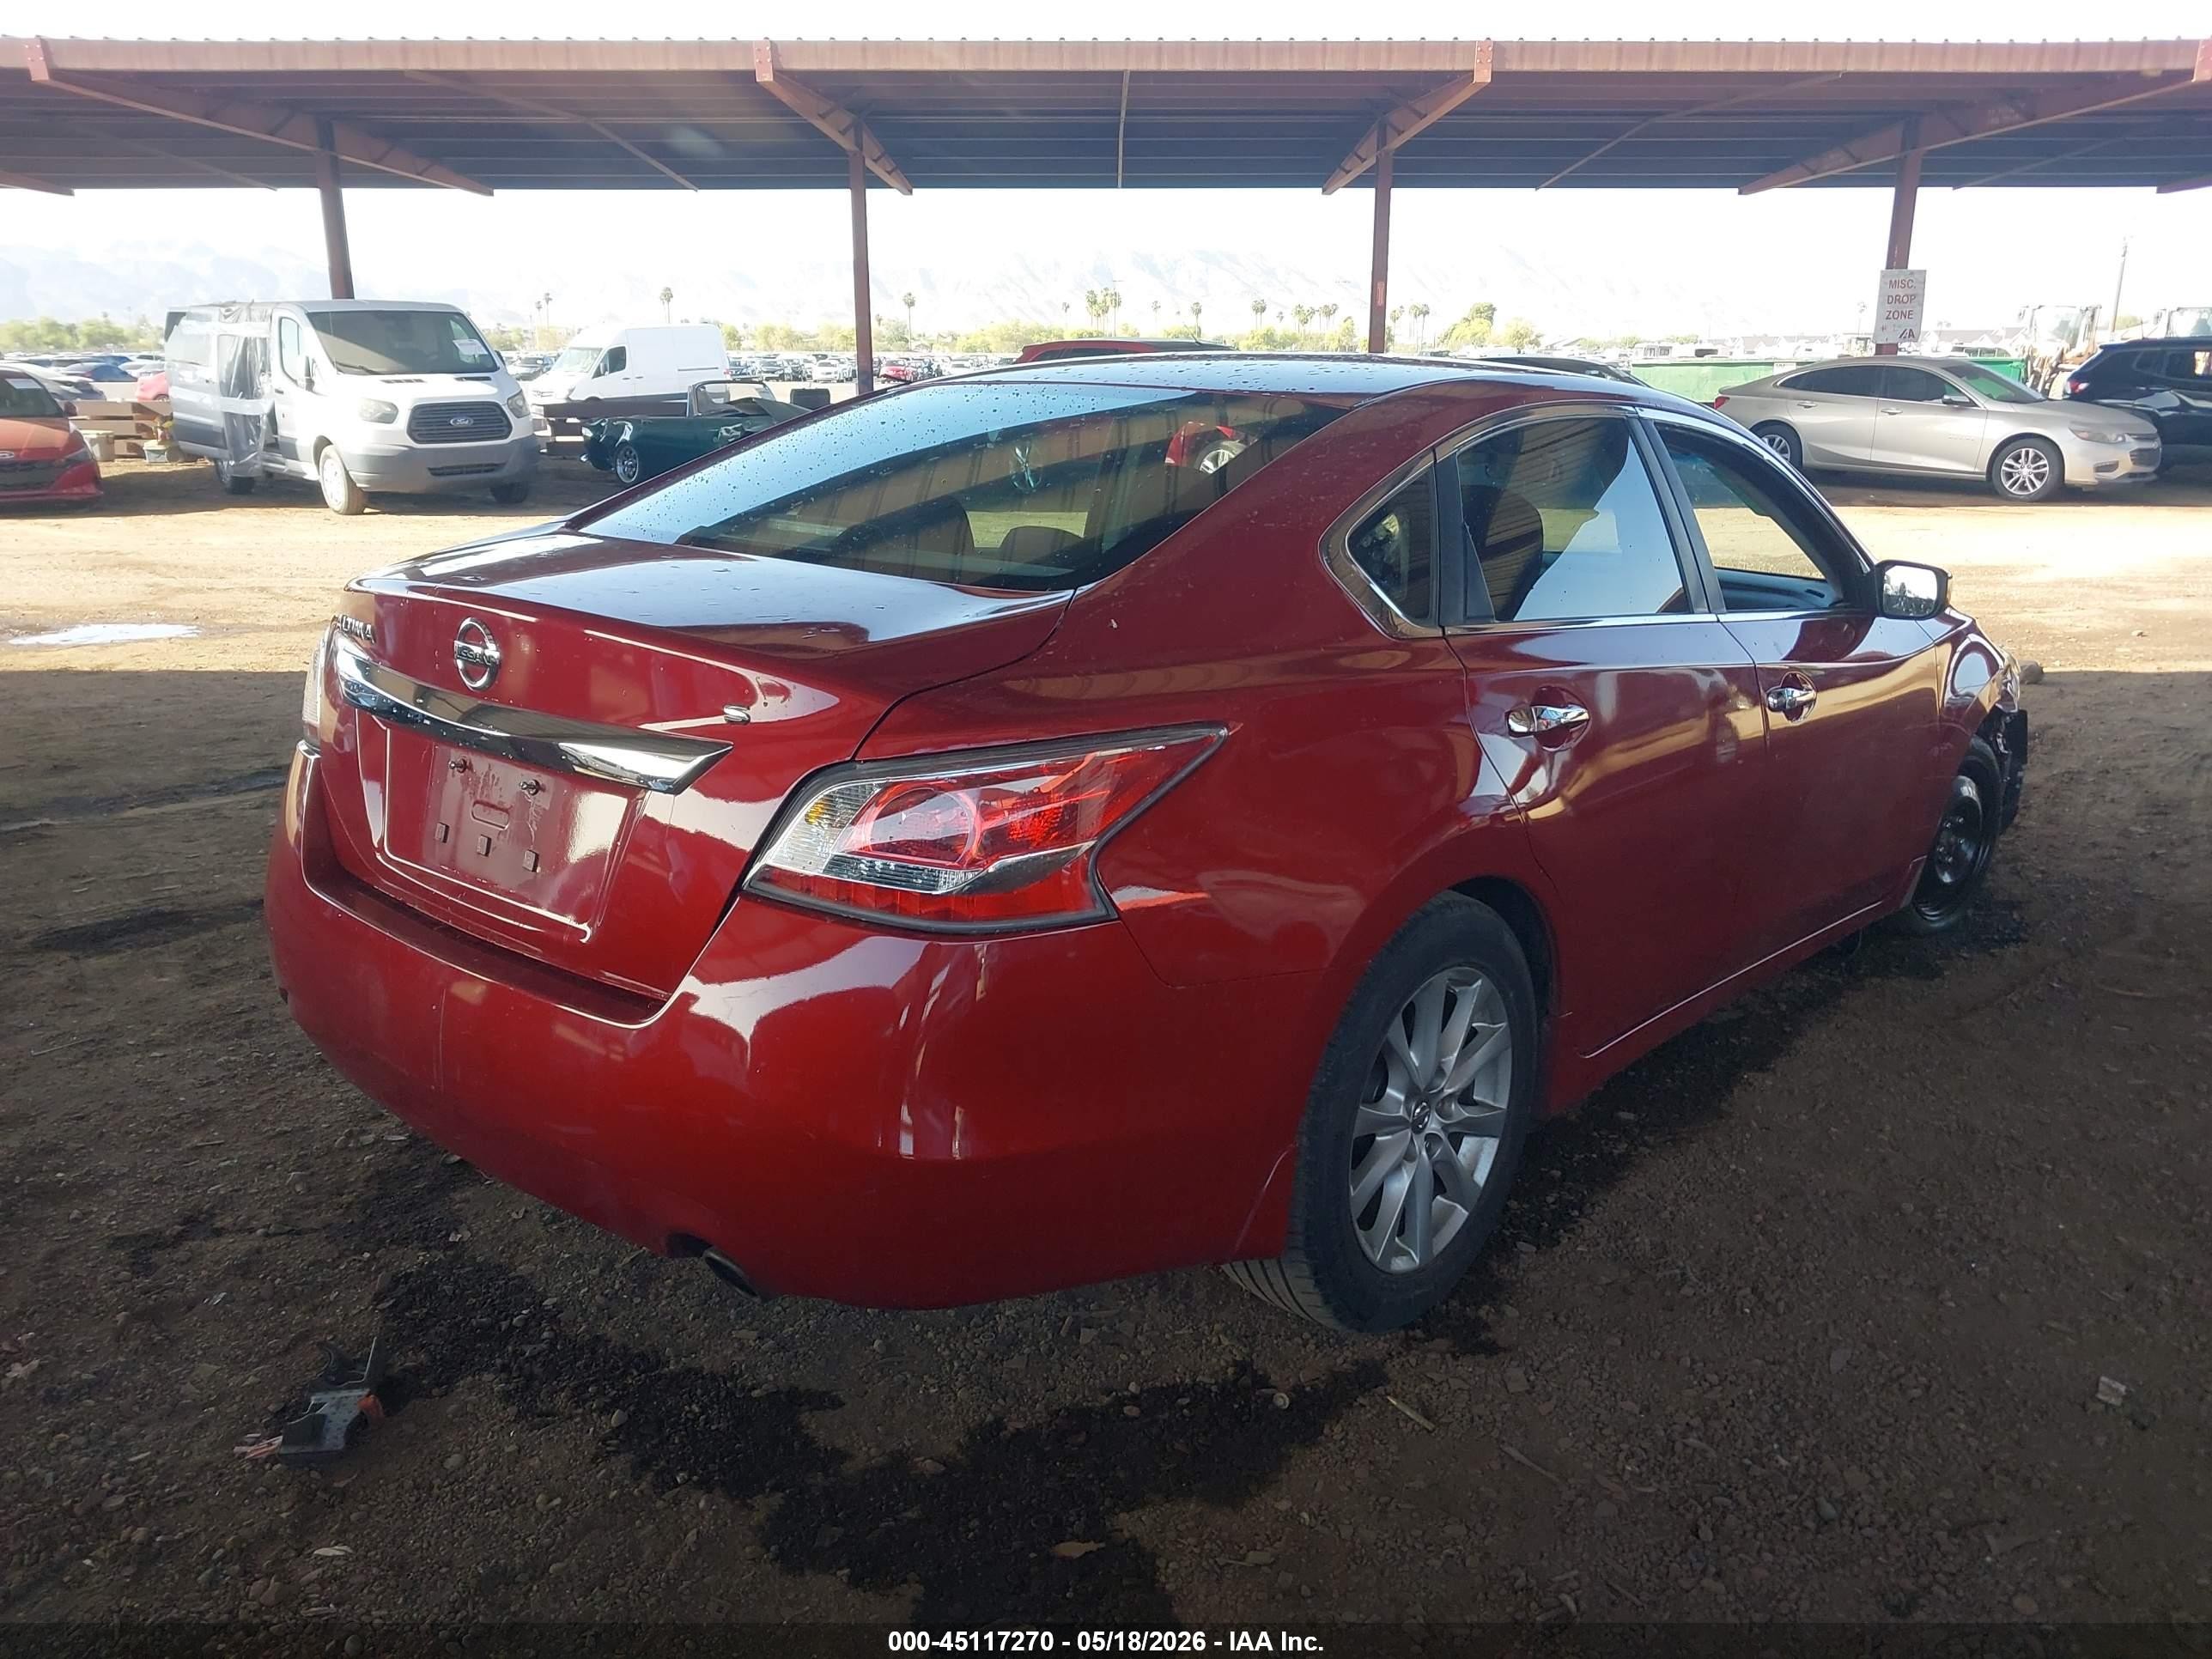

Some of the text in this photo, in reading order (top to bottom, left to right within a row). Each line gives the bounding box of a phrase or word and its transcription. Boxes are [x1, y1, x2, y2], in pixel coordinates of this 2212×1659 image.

[1889, 278, 1917, 289] MISC.
[1887, 295, 1916, 305] DROP
[1885, 309, 1914, 320] ZONE
[331, 613, 375, 644] ALTIMA
